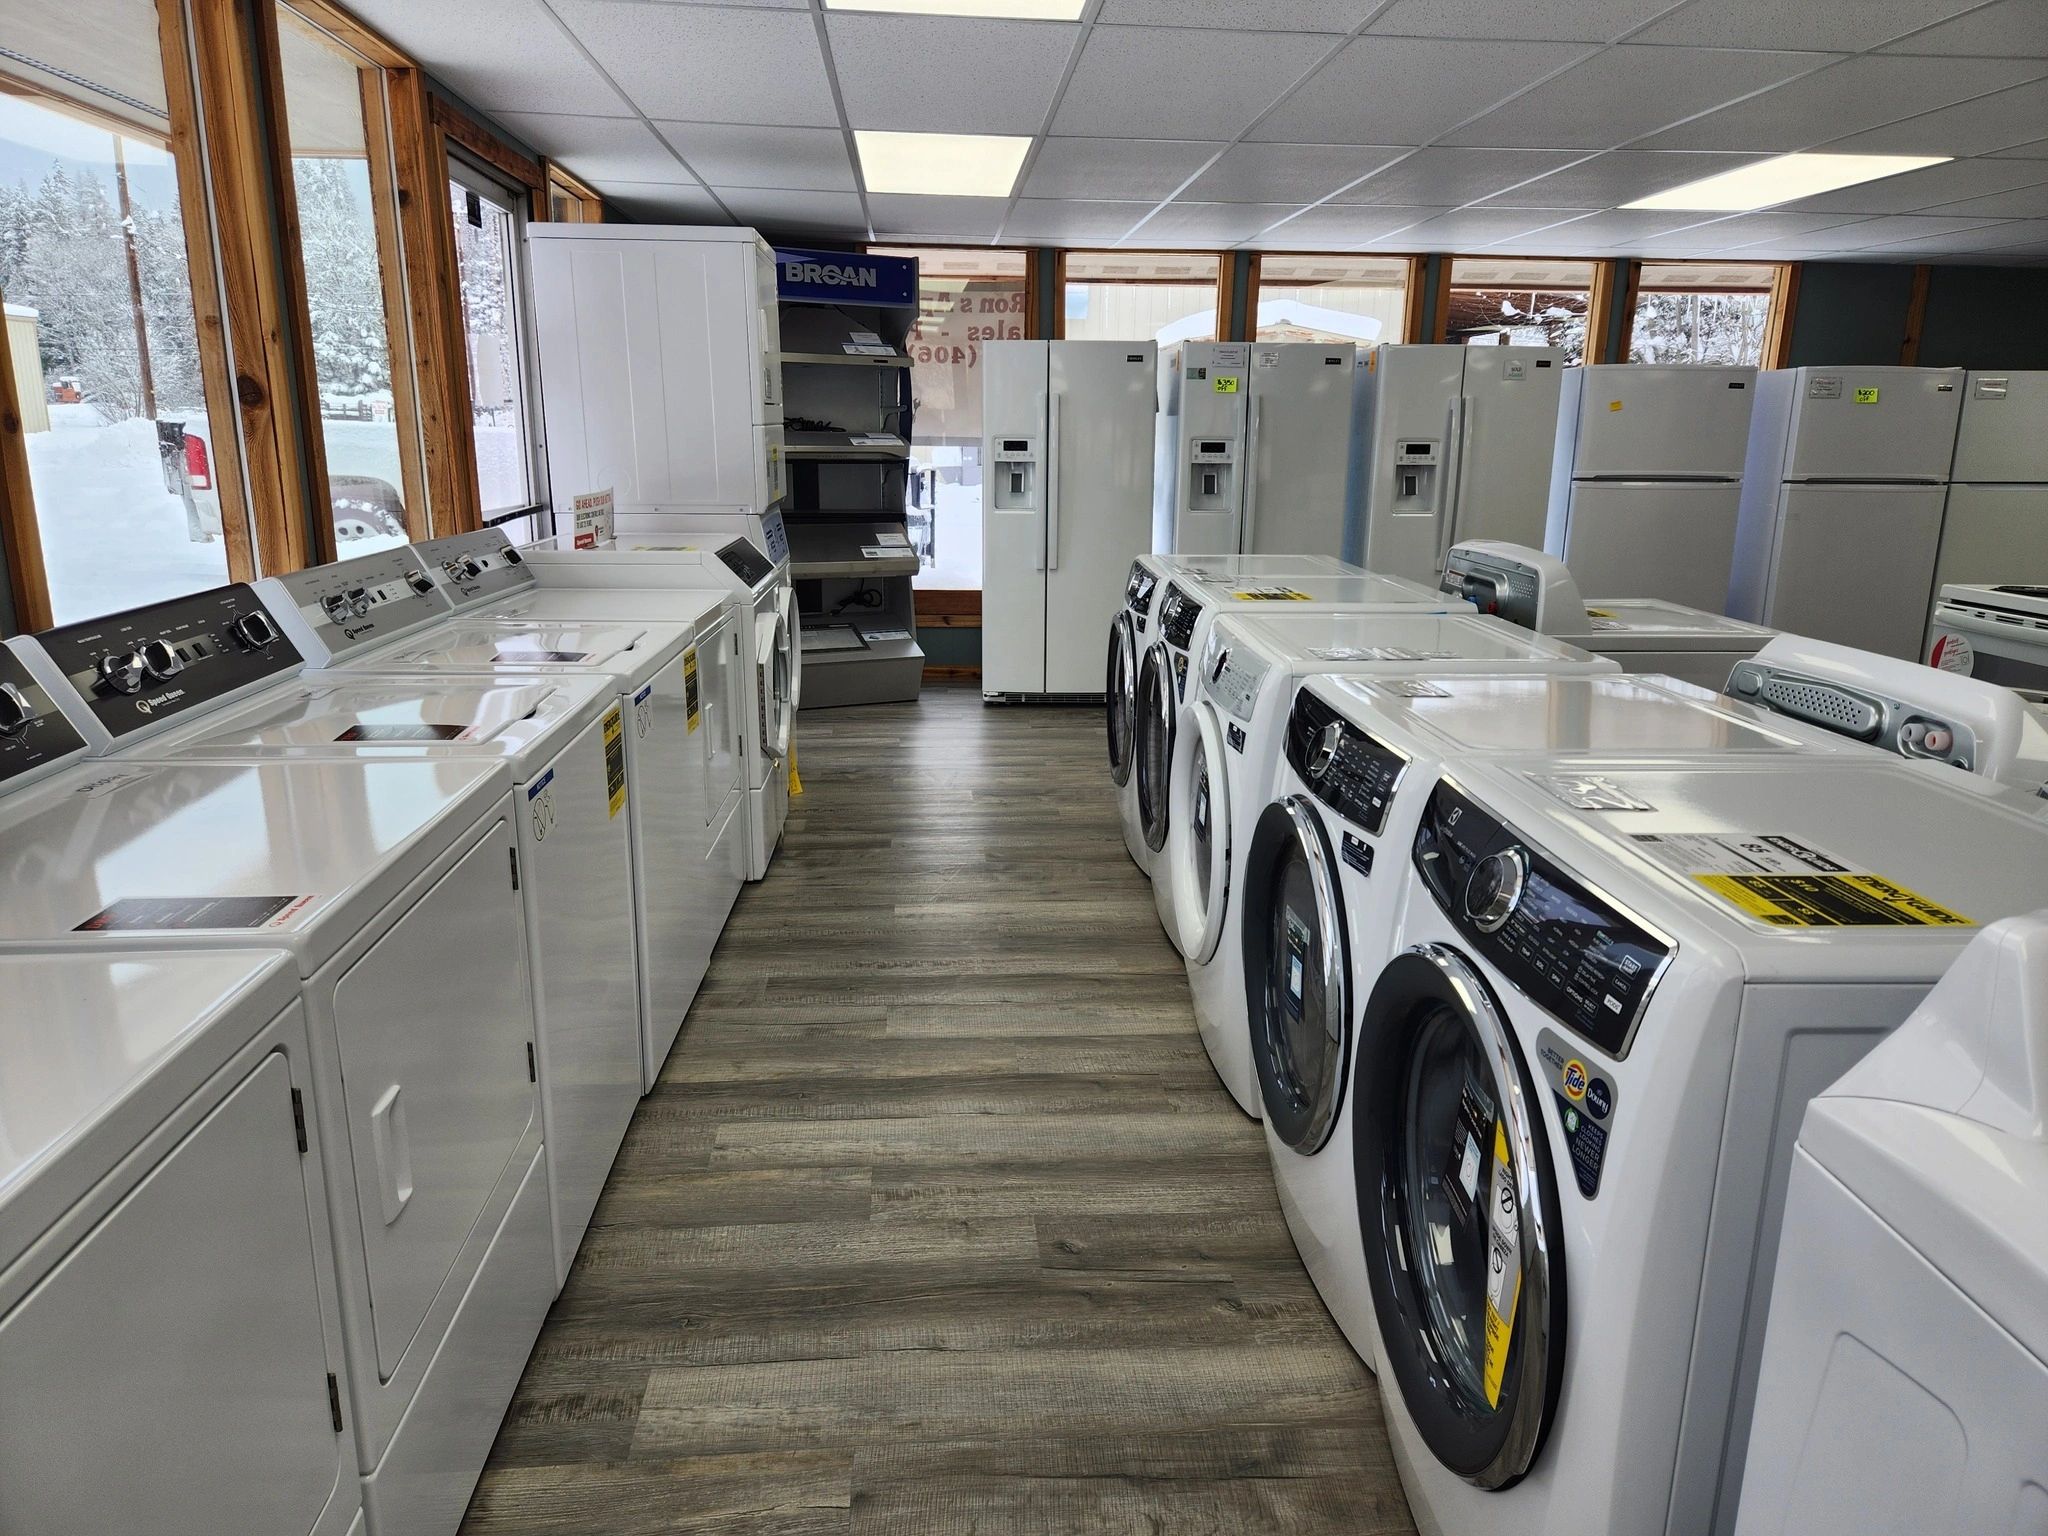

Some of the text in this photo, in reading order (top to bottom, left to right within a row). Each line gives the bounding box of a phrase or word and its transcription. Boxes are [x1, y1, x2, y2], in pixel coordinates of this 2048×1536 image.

[785, 262, 877, 288] BROAN
[148, 694, 168, 706] Speed
[165, 689, 185, 700] Queen
[1564, 1067, 1585, 1091] Tide
[1587, 1088, 1609, 1113] Downy
[1578, 1132, 1601, 1153] LOOKING
[1580, 1125, 1602, 1146] CLOTHES
[1588, 1123, 1604, 1140] KEEPS
[1571, 1144, 1599, 1171] LONGER
[1575, 1136, 1600, 1162] NEWER
